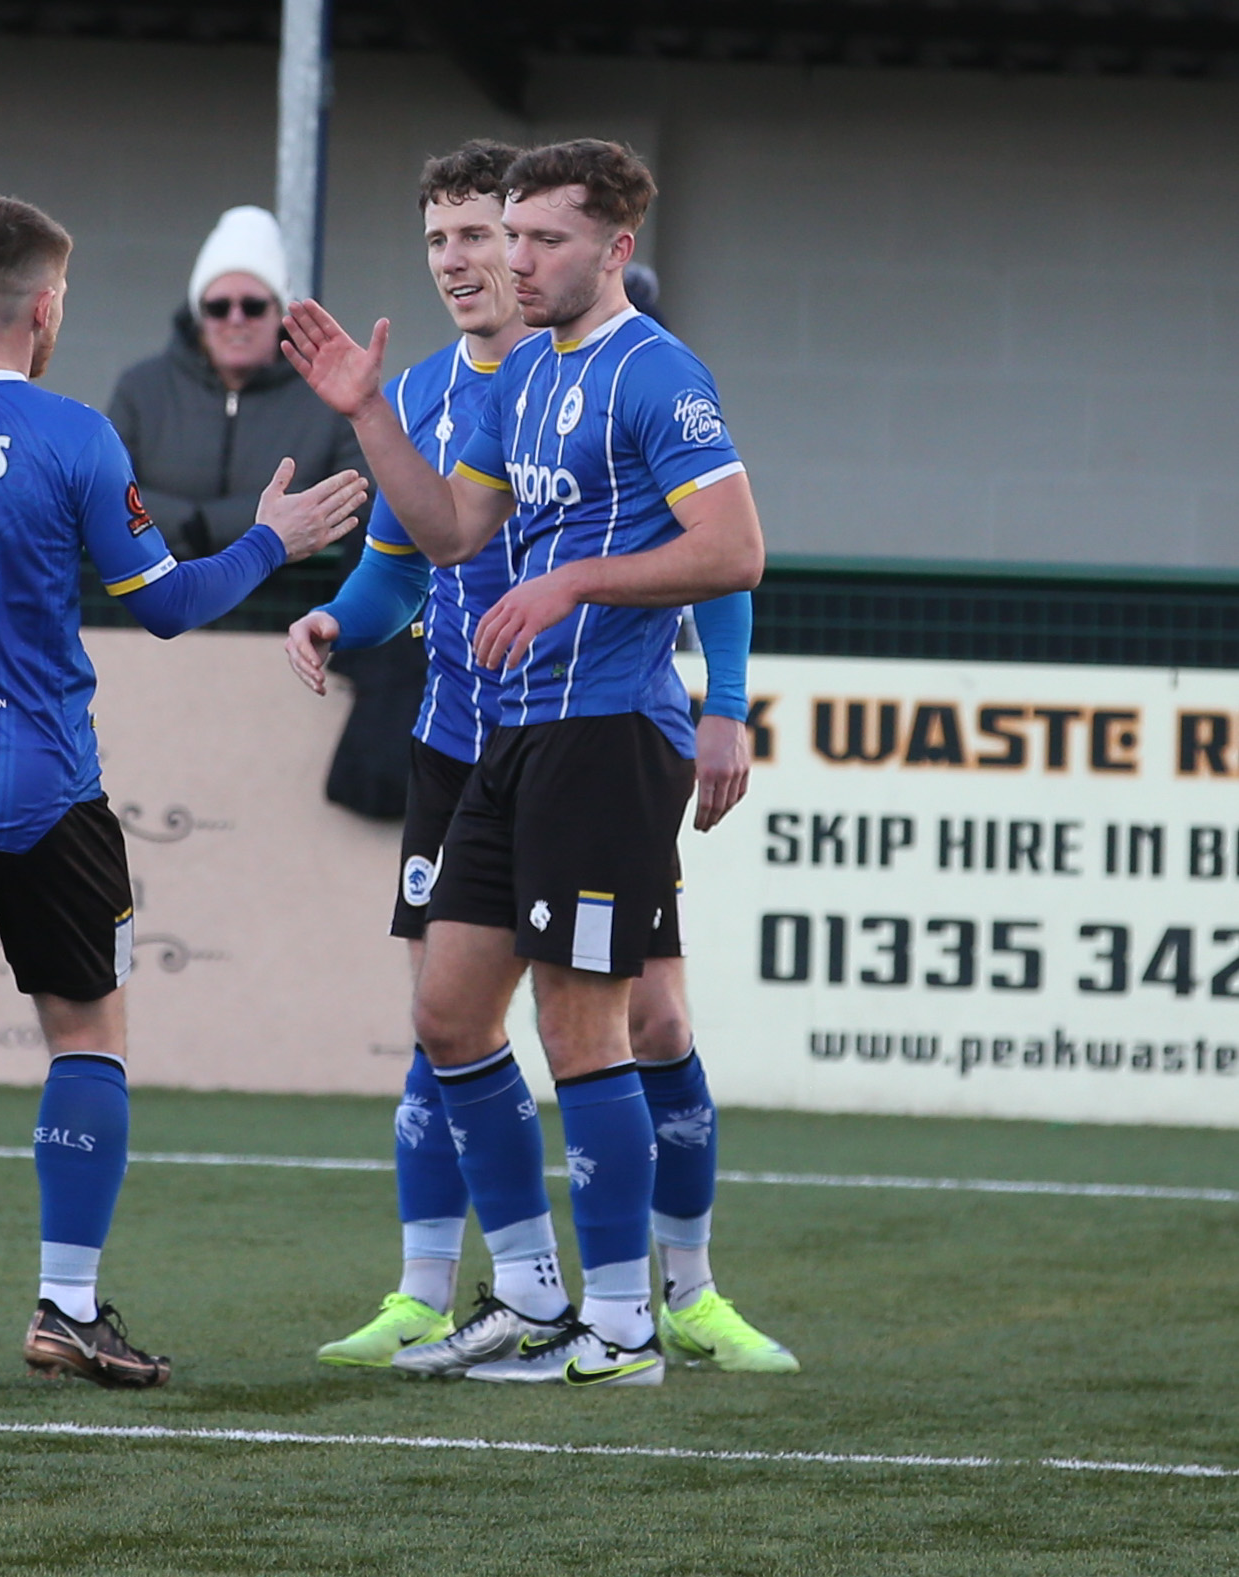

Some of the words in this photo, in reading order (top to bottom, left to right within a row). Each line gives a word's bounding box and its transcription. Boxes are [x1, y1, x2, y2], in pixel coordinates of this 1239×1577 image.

[810, 695, 1144, 774] WASTE
[1174, 707, 1239, 778] R
[766, 813, 915, 868] SKIP
[937, 818, 1084, 876] HIRE
[1106, 824, 1167, 878] IN
[1190, 826, 1239, 879] B
[759, 912, 1044, 992] 01335
[1077, 923, 1239, 1000] 342
[809, 1027, 1239, 1077] www.peakwaste
[32, 1127, 96, 1152] SEALS
